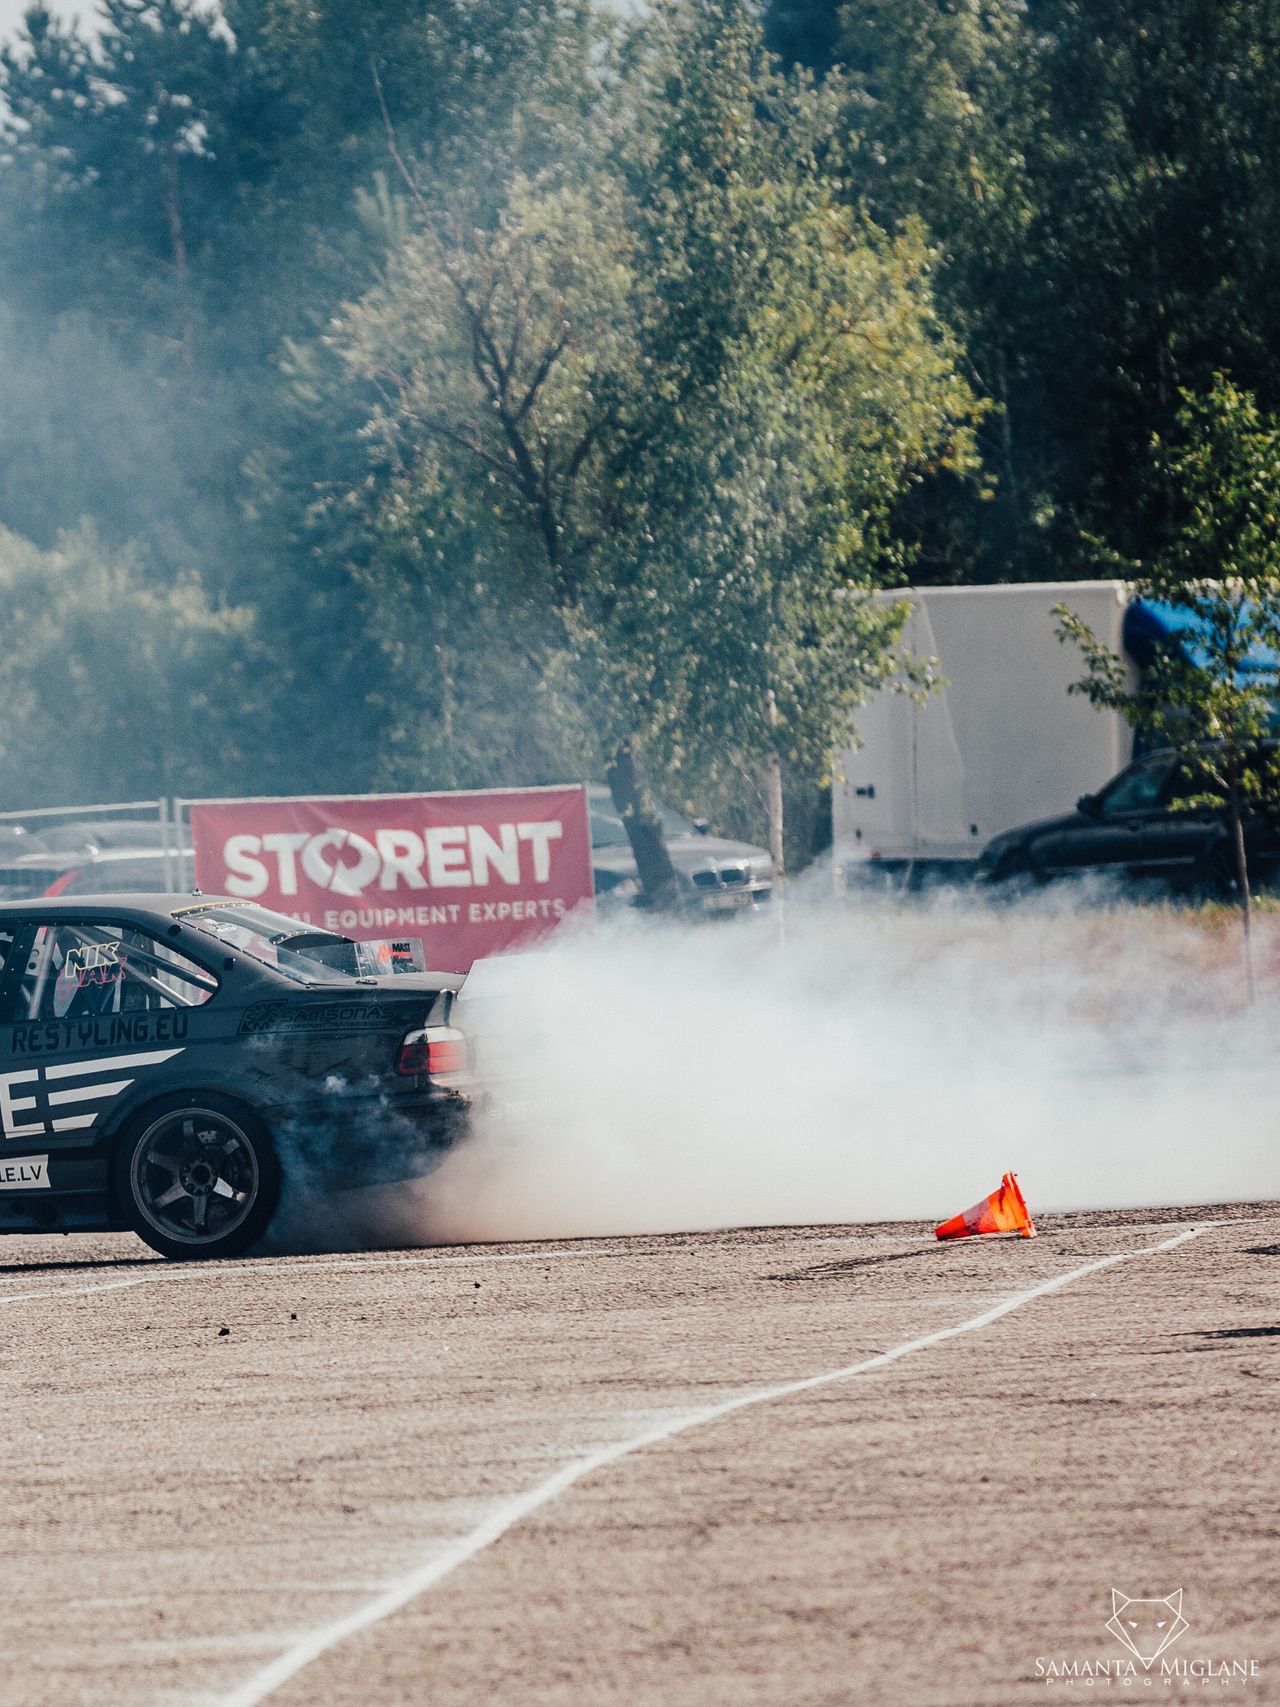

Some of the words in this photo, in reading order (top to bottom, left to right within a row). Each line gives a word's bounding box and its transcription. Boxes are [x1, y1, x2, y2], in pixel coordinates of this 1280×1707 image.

[223, 821, 563, 898] STORENT
[325, 906, 461, 930] EQUIPMENT
[469, 898, 567, 927] EXPERTS
[392, 942, 411, 953] MAST
[12, 1013, 189, 1053] RESTYLING.EU
